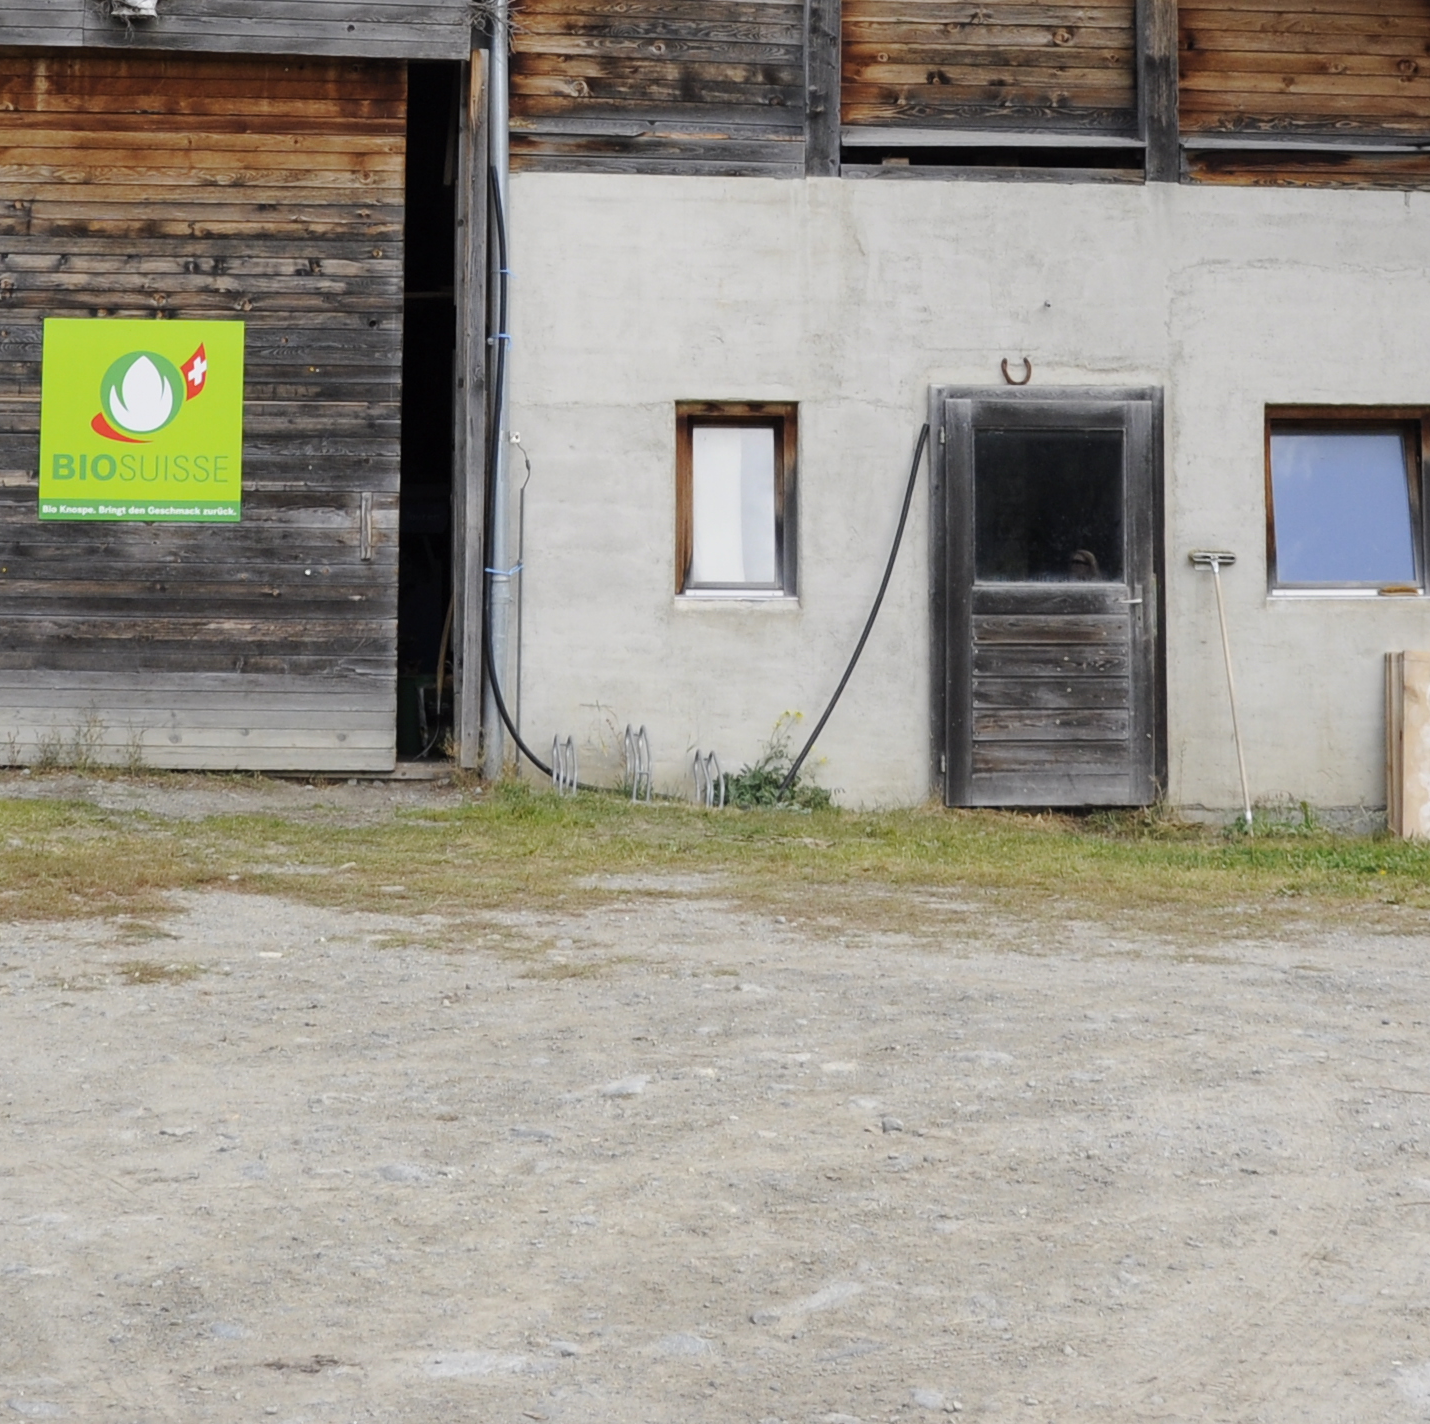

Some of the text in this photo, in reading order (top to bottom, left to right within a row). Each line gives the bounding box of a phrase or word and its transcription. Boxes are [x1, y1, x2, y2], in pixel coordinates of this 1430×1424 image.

[42, 505, 237, 517] Bio Knospe. Bringt den Geschmack zurück.
